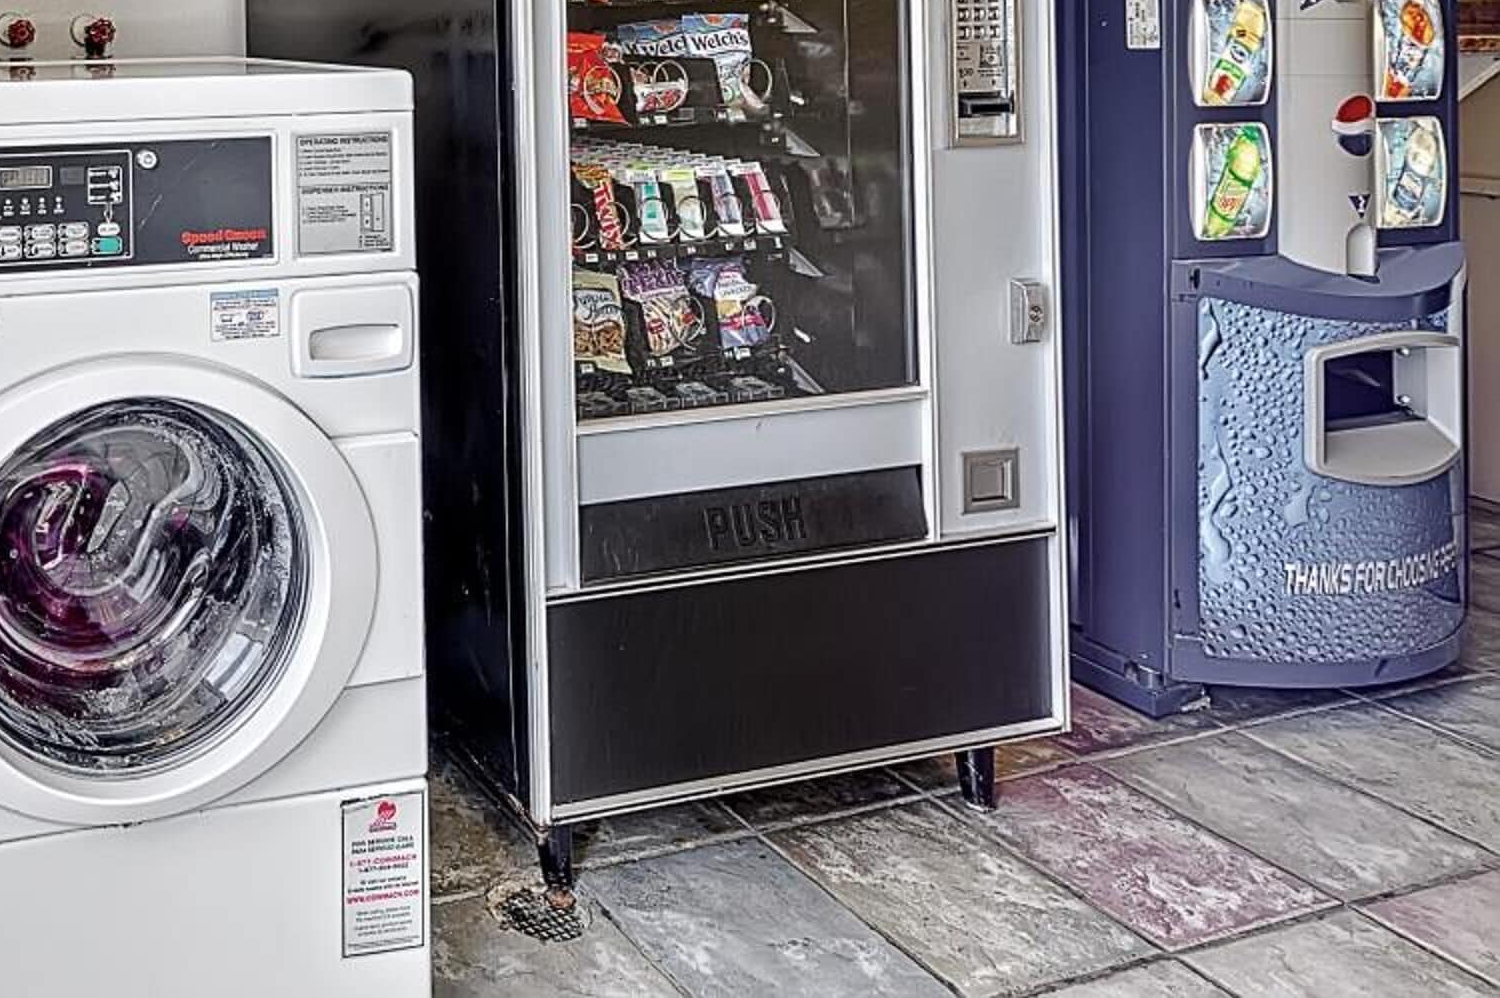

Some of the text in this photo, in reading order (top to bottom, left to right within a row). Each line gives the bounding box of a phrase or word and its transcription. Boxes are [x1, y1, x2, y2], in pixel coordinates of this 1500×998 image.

[691, 31, 748, 51] Welch's
[703, 498, 805, 550] PUSH
[1284, 561, 1352, 594] THANKS
[1353, 559, 1387, 593] FOR
